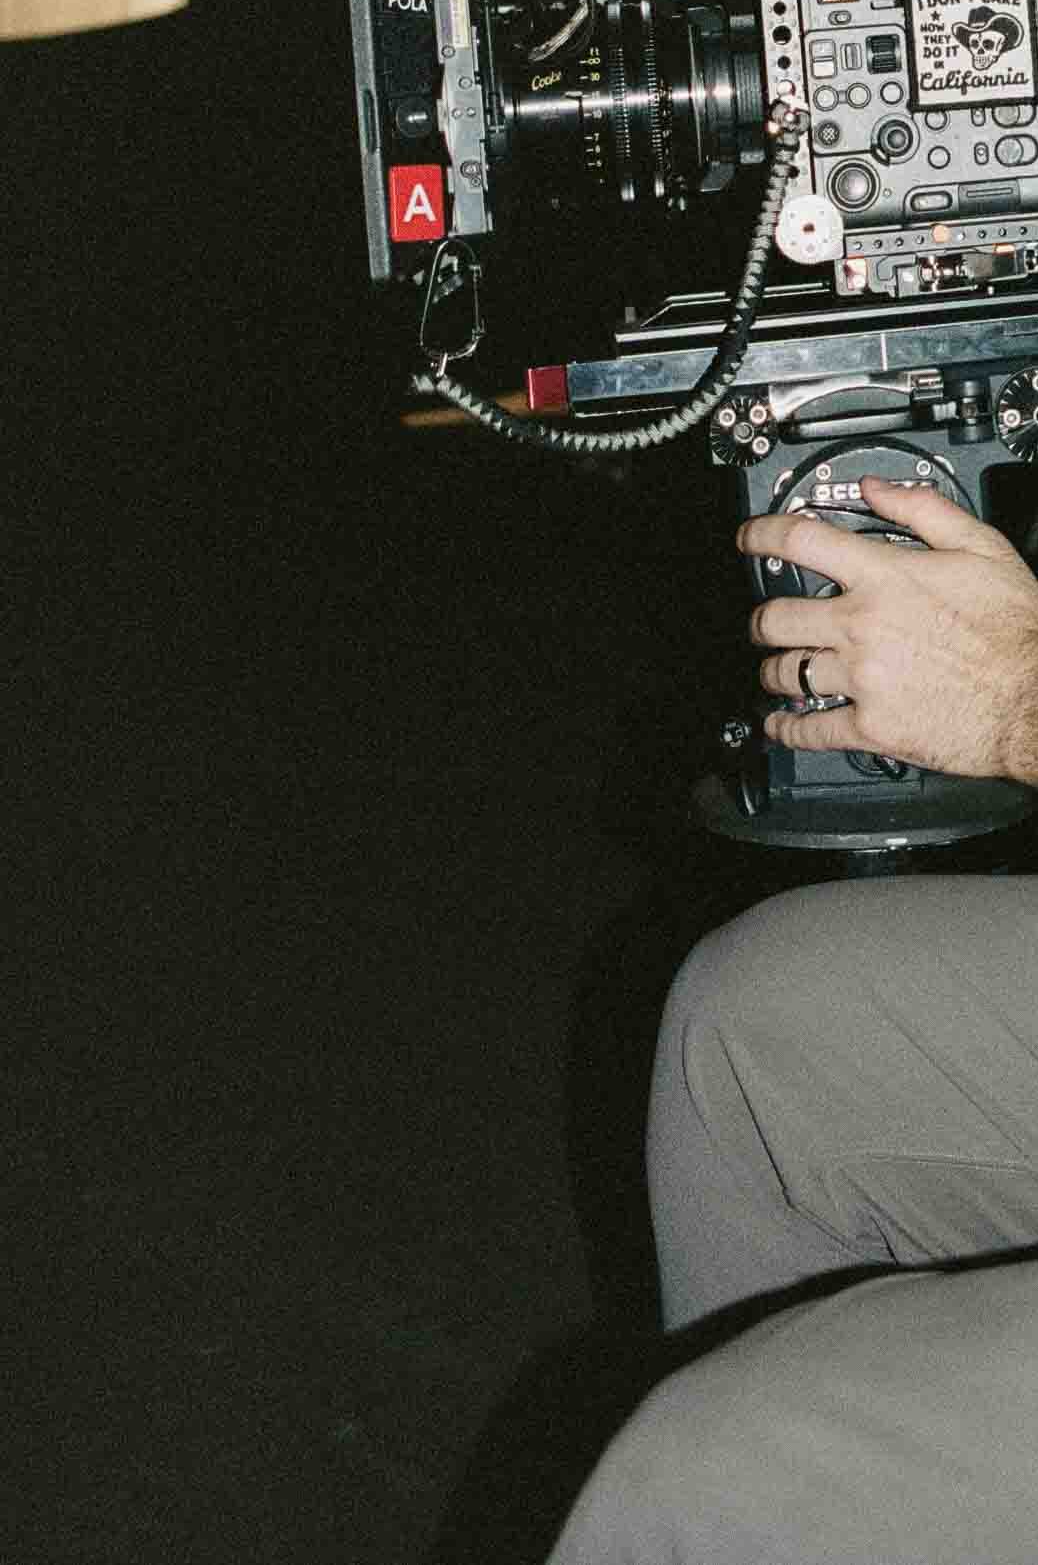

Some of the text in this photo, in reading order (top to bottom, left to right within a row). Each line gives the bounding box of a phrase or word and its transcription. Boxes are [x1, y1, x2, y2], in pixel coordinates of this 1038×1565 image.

[919, 22, 945, 33] HOW
[923, 35, 951, 45] THEY
[922, 45, 959, 59] DO IT
[919, 66, 1029, 95] California
[402, 182, 436, 222] A
